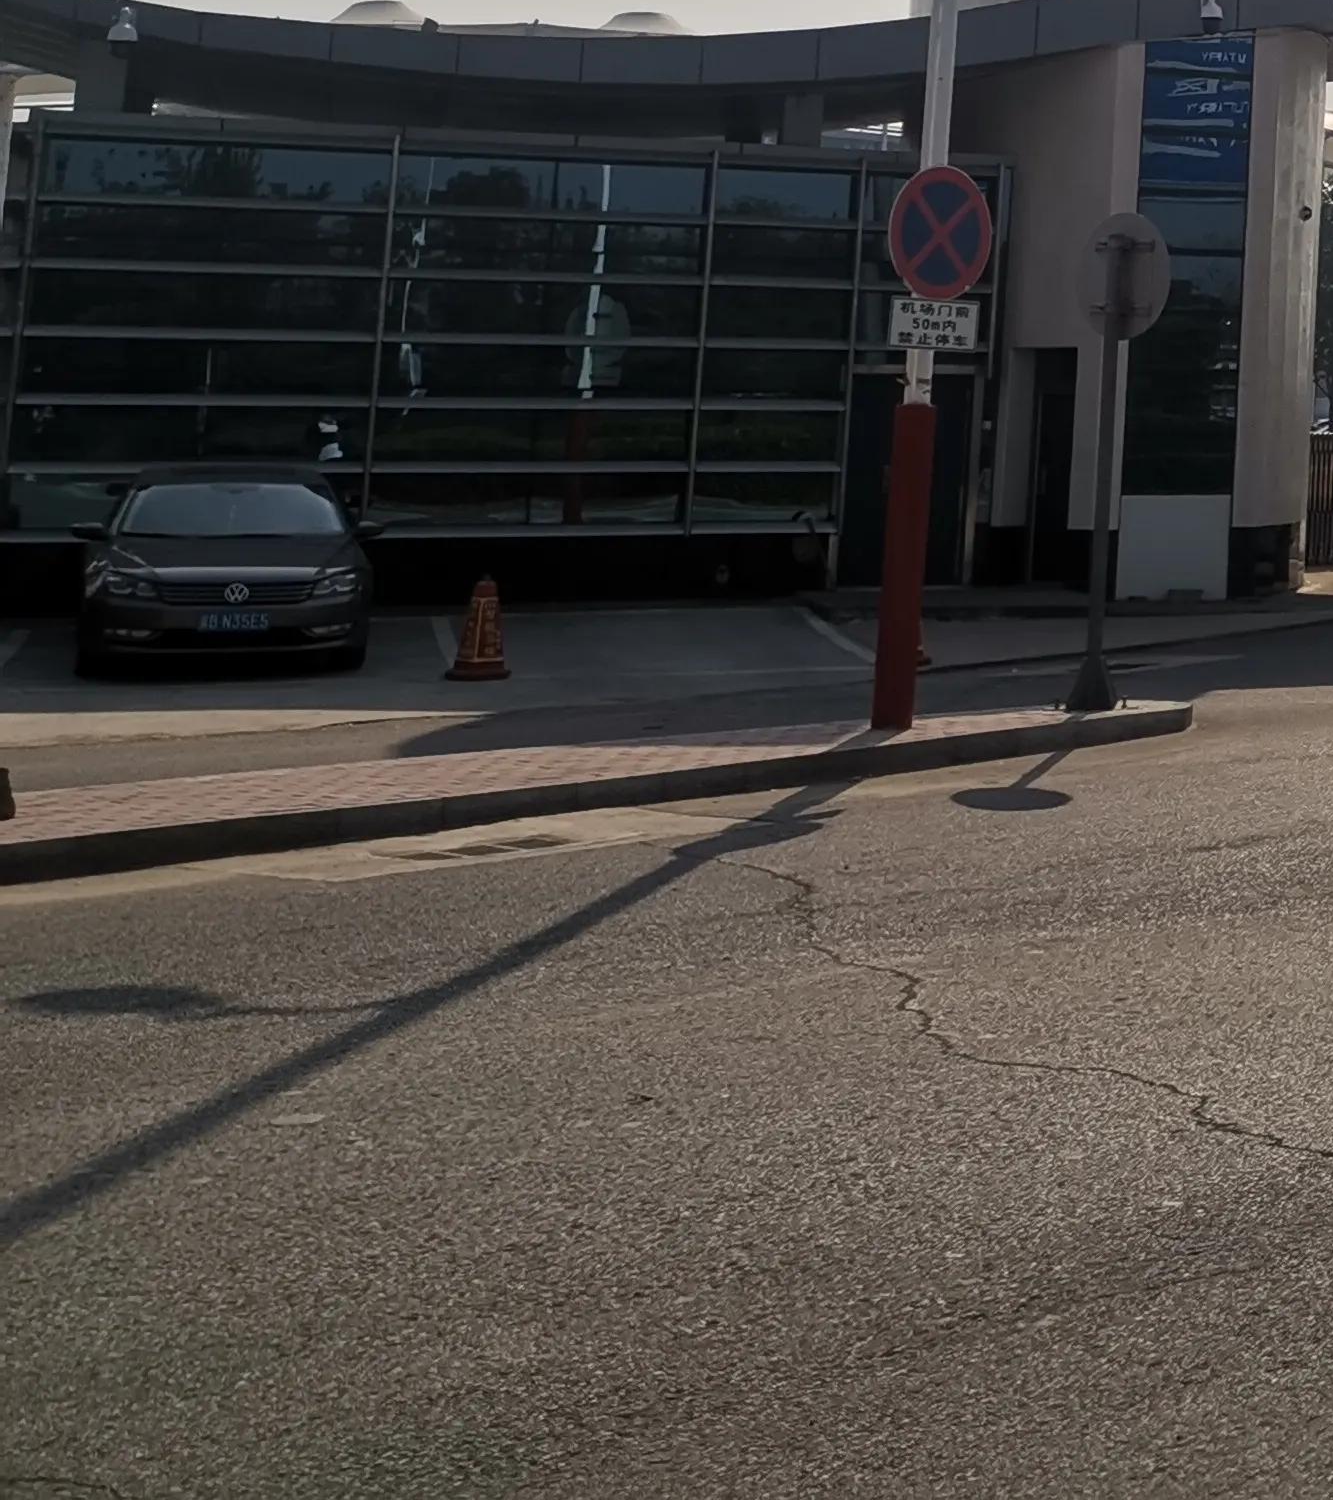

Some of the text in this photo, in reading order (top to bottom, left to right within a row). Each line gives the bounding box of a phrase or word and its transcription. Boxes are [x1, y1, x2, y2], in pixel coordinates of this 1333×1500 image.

[900, 302, 970, 318] 机场门前
[912, 317, 957, 333] 50m内
[897, 331, 969, 347] 禁止停车
